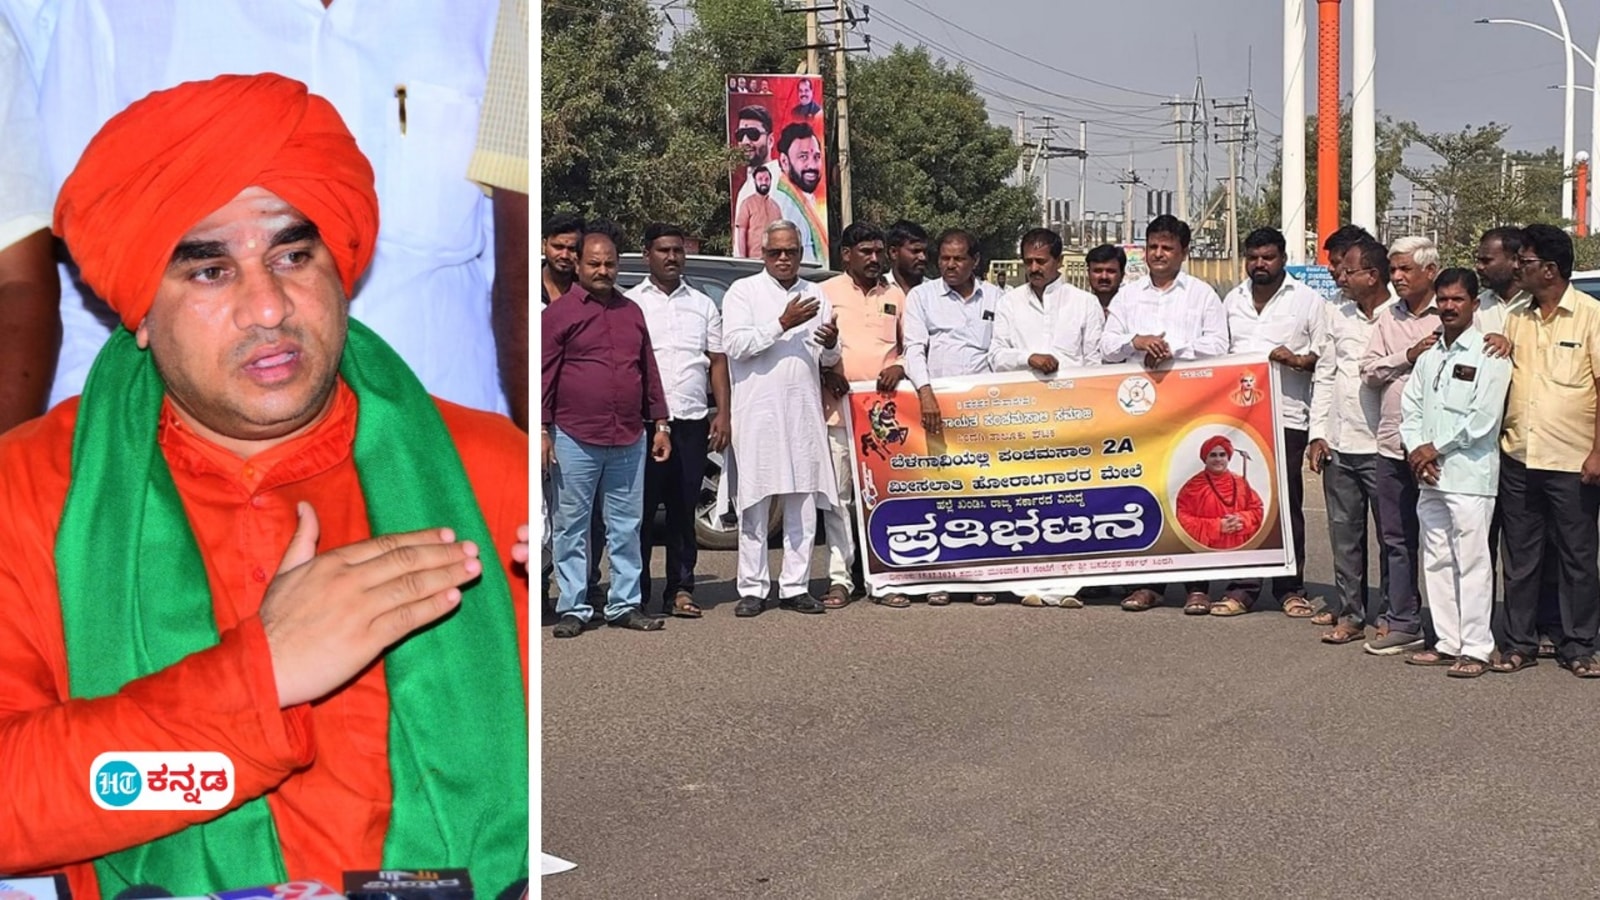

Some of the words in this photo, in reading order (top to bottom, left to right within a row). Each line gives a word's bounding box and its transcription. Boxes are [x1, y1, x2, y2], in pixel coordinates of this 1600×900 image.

[890, 451, 990, 470] ಬೆಳಗಾವಿಯಲ್ಲಿ
[998, 444, 1091, 464] ಪಂಚಮಸಾಲಿ
[1102, 437, 1134, 455] 2A
[888, 478, 963, 494] ಮೀಸಲಾತಿ
[972, 467, 1091, 490] ಹೋರಾಟಗಾರರ
[1100, 462, 1142, 480] ಮೇಲೆ
[886, 503, 1145, 566] ಪ್ರತಿಭಟನೆ
